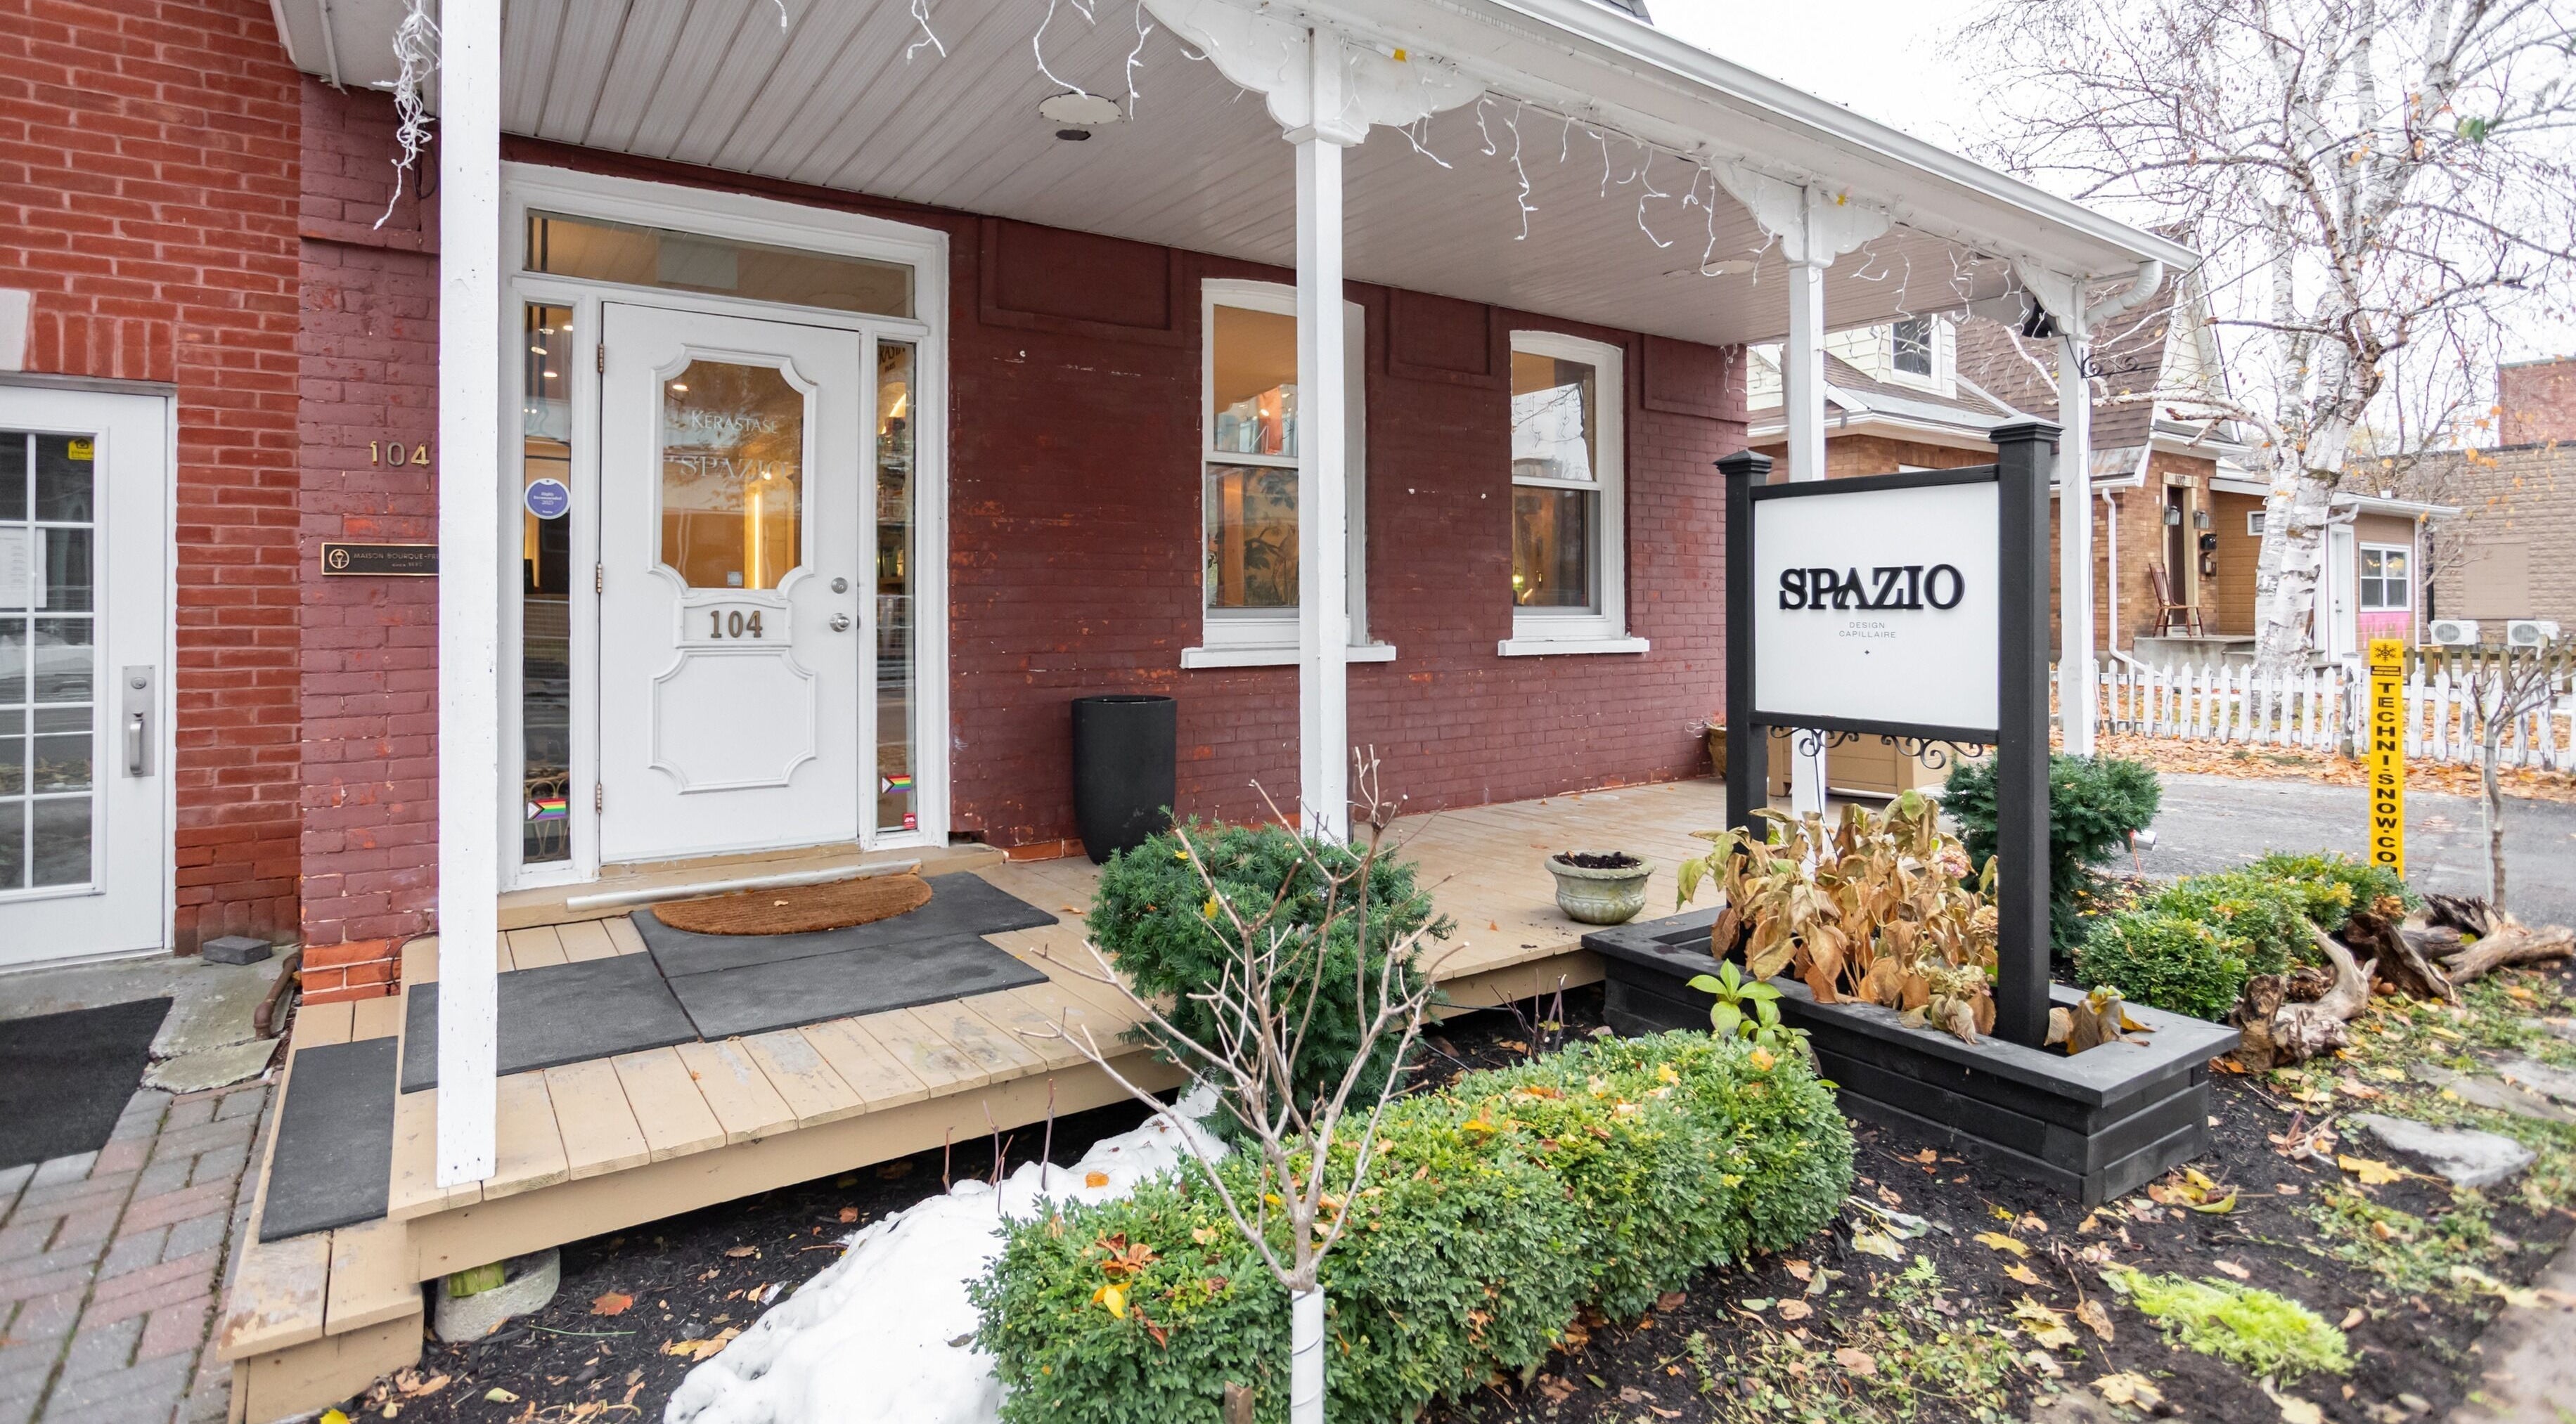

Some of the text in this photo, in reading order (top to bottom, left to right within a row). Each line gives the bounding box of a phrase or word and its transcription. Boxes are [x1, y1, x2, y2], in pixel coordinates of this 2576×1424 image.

[370, 441, 430, 467] 104
[1779, 564, 1965, 610] SPAZIO
[711, 610, 763, 638] 104
[1838, 630, 1897, 639] CAPILLAIRE
